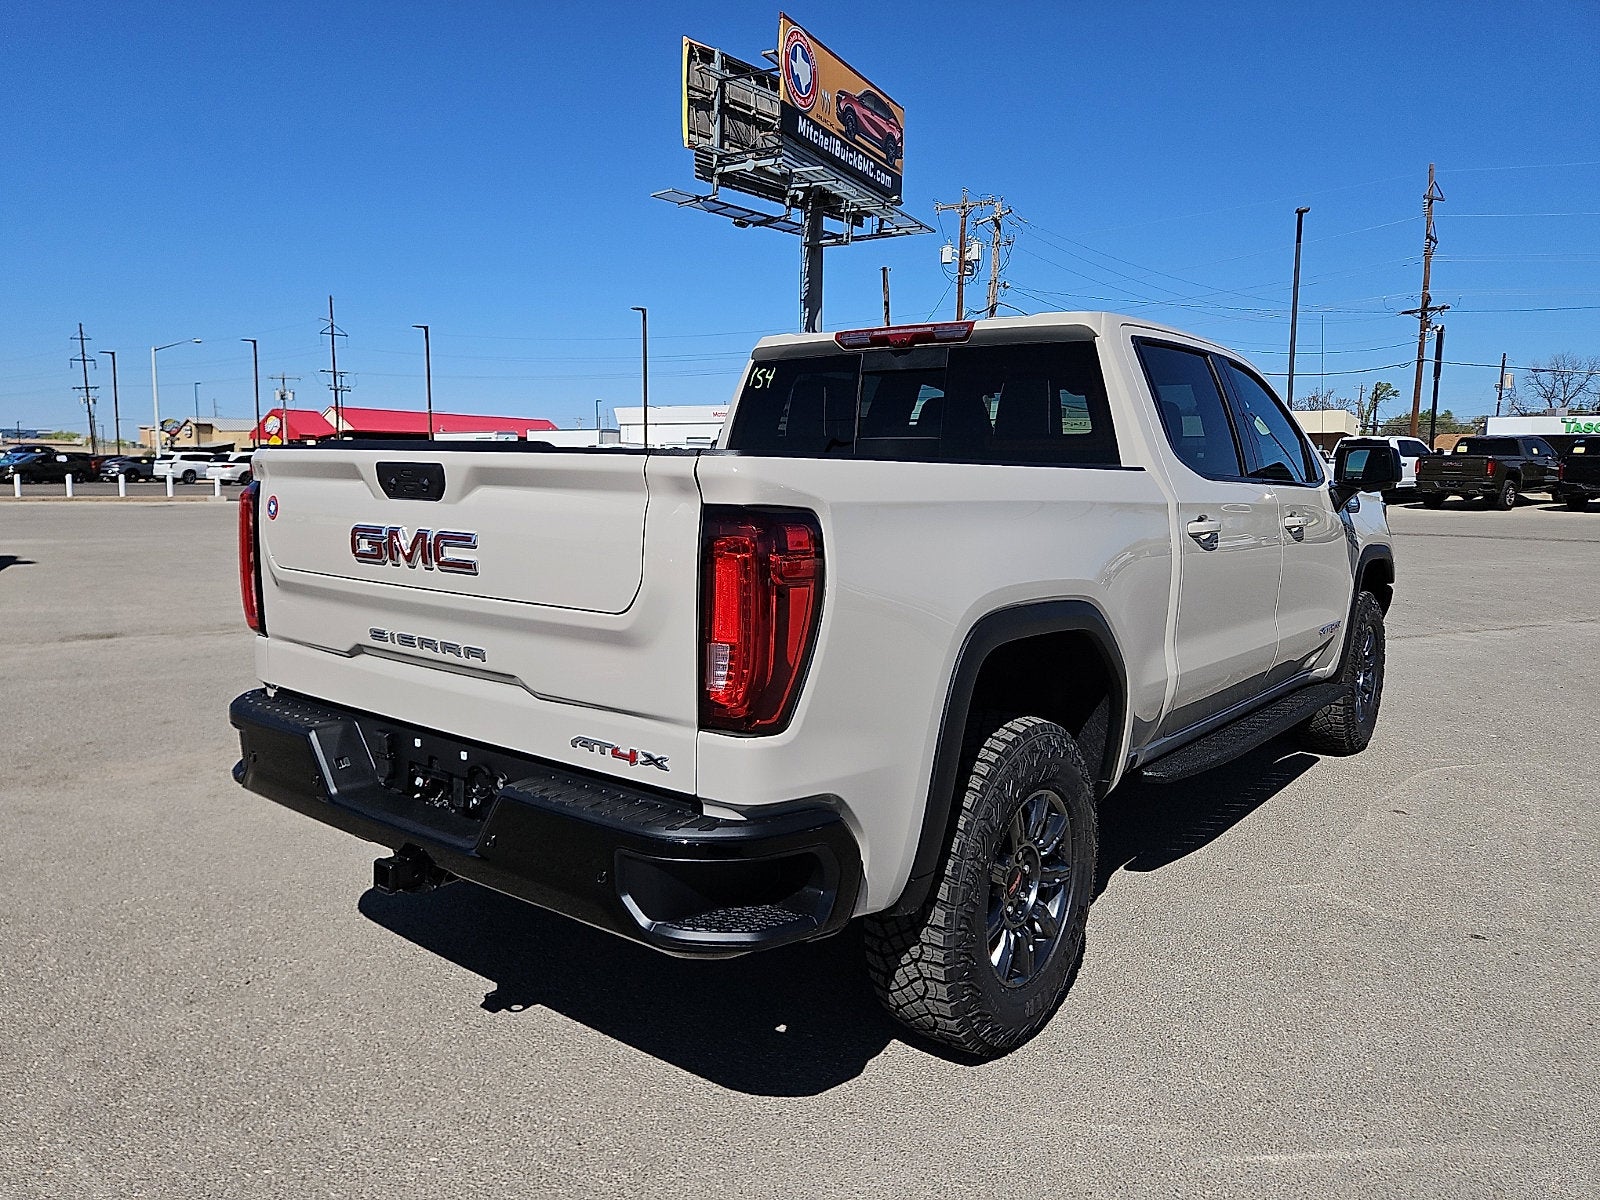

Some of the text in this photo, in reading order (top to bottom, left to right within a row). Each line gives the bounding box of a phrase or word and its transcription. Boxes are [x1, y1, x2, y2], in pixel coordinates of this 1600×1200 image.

[816, 113, 834, 129] BUICK
[797, 115, 892, 188] MitchellBuickGMC.com
[749, 367, 776, 389] 154
[350, 524, 480, 576] GMC
[369, 627, 487, 662] SIERRA
[570, 735, 670, 772] AT4X
